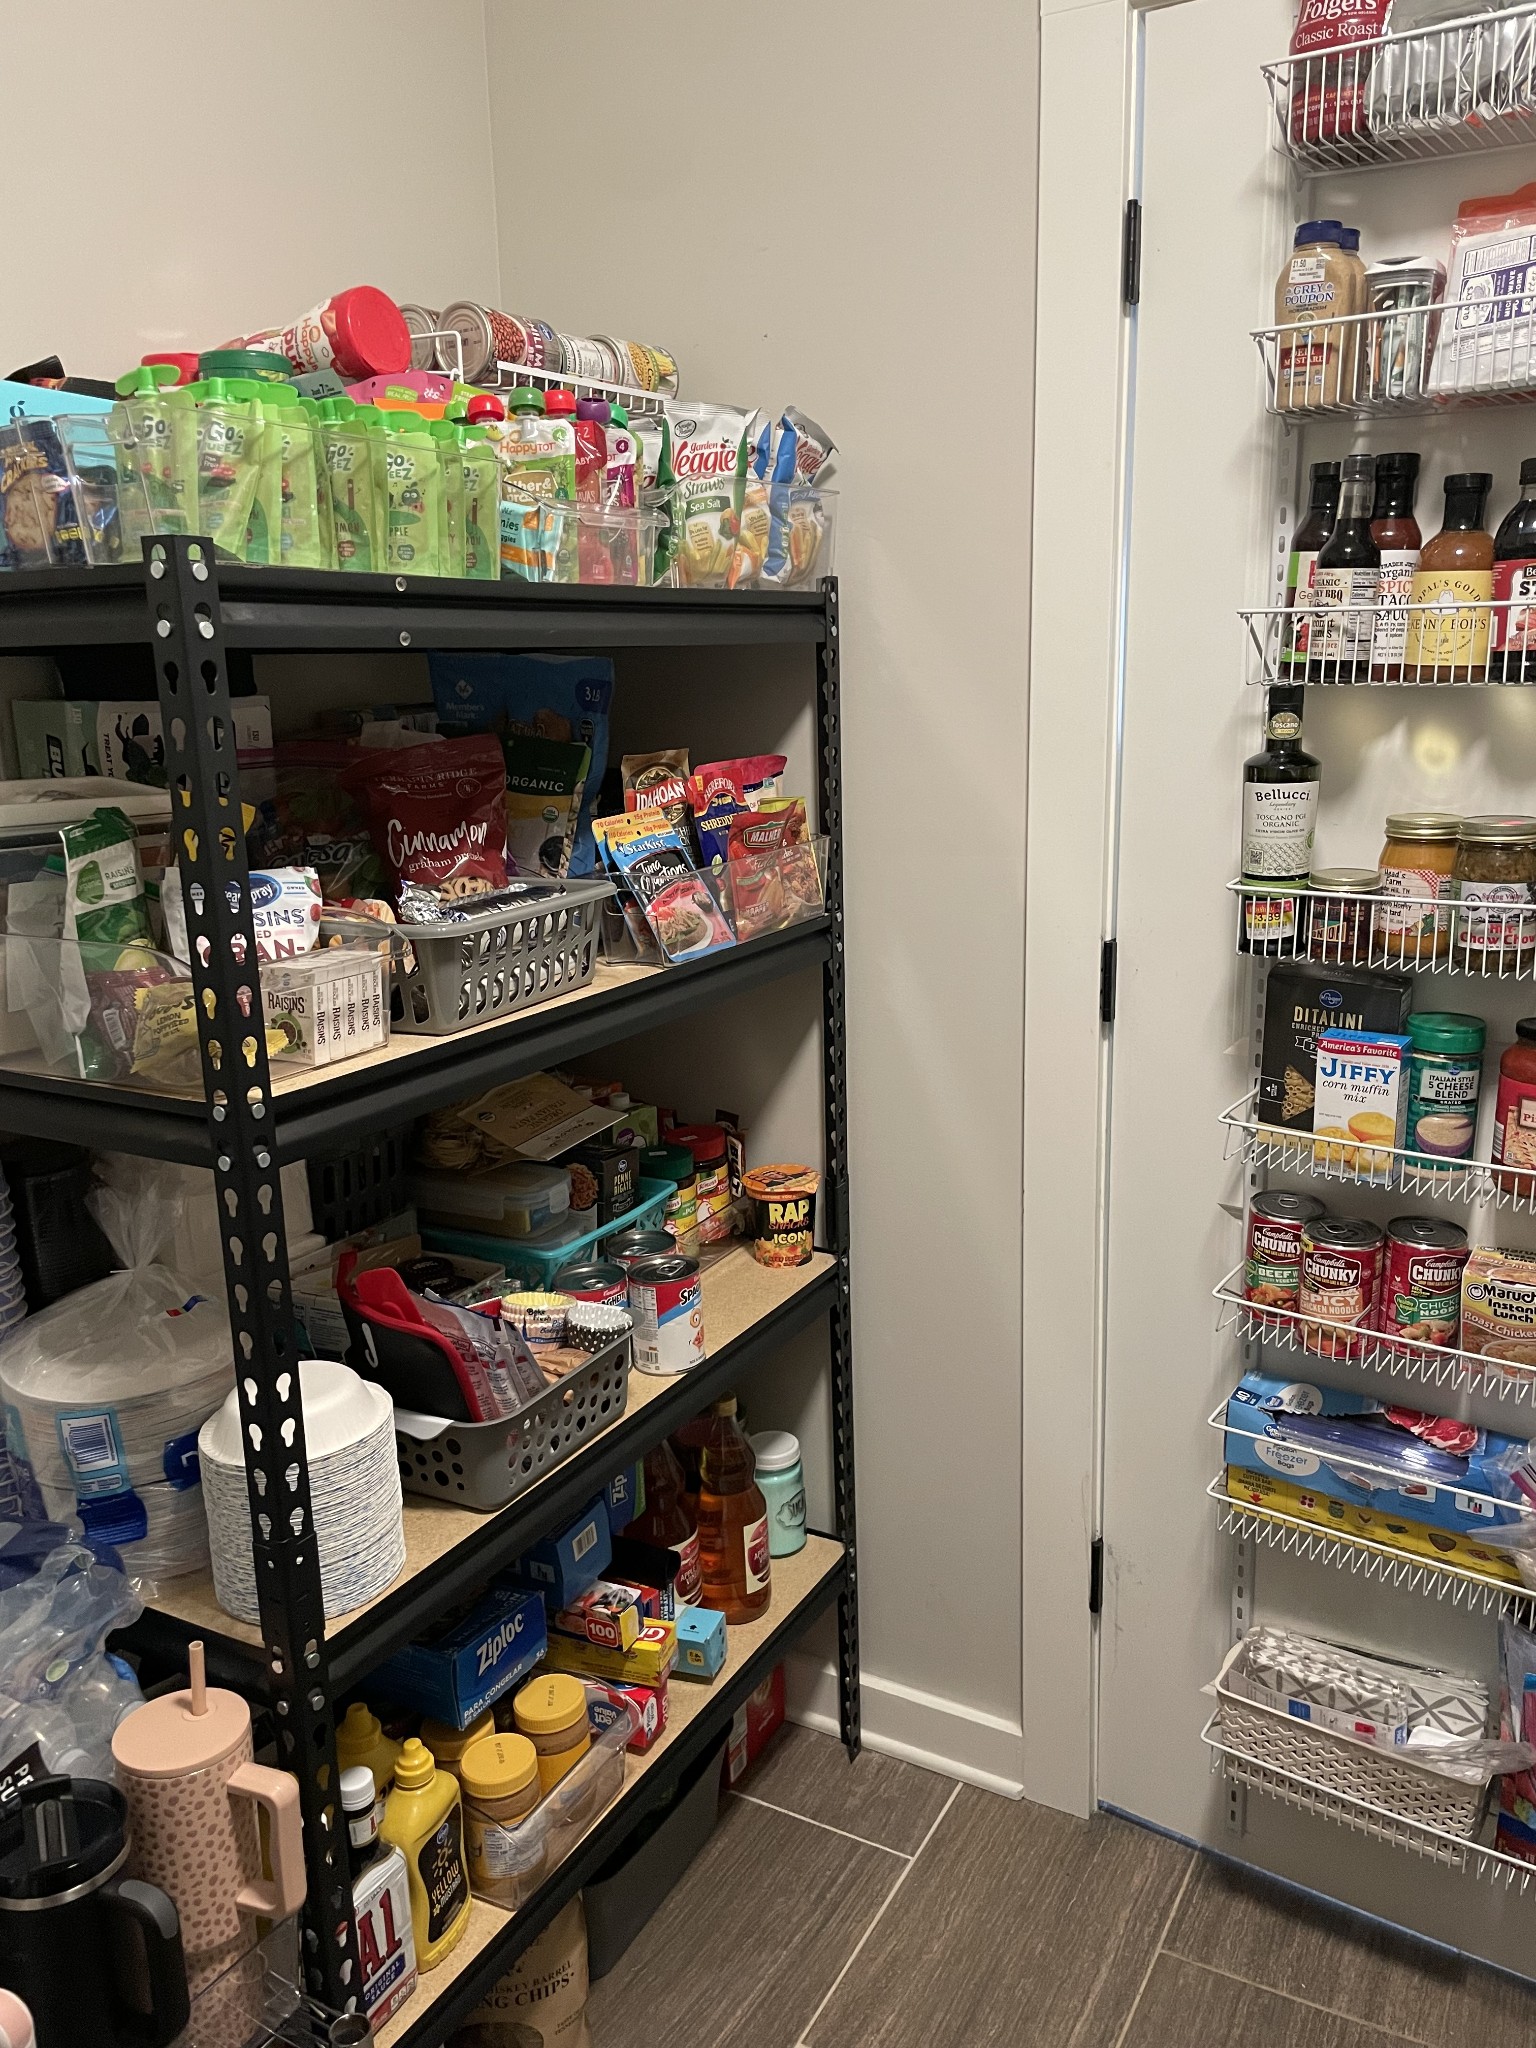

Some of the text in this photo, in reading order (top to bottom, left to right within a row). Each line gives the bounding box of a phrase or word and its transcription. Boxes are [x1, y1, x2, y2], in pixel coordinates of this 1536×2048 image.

[1301, 0, 1377, 23] Folgers
[1295, 22, 1377, 48] Classic Roast
[1293, 283, 1324, 295] GREY
[1285, 291, 1335, 306] POUPON
[690, 441, 718, 453] garden
[672, 440, 737, 481] Veggie
[684, 476, 725, 499] Straws
[690, 499, 721, 513] Sea Salt
[1325, 589, 1343, 603] BBQ
[1417, 580, 1481, 603] OPAL'S GOLD
[592, 688, 601, 702] LB
[445, 702, 485, 712] Member's
[1271, 720, 1299, 729] Toscano
[103, 733, 112, 767] TREAT
[438, 768, 478, 780] RIDGE
[407, 782, 445, 790] FARMS
[506, 775, 564, 793] ORGANIC
[636, 781, 686, 812] IDAHOAN
[1255, 789, 1310, 802] Bellucci
[605, 818, 624, 826] Calories
[643, 810, 660, 818] Protein
[1256, 813, 1293, 821] TOSCANO
[387, 818, 488, 868] Cinnamon
[624, 838, 667, 855] StarKist
[105, 866, 135, 881] RAISINS
[408, 857, 451, 874] graham
[636, 859, 662, 875] Tuna
[1386, 878, 1402, 886] Farm
[1460, 932, 1498, 945] Chow
[268, 993, 307, 1013] RAISINS
[156, 1012, 181, 1026] LEMON
[347, 1002, 356, 1036] RAISINS
[362, 998, 370, 1031] RAISINS
[1293, 1005, 1363, 1030] DITALINI
[317, 1011, 325, 1046] RAISINS
[333, 1006, 341, 1040] RAISINS
[1291, 1022, 1325, 1033] ENRICHED
[1321, 1040, 1398, 1058] America's Favorite
[1322, 1080, 1390, 1097] corn muffin
[1428, 1081, 1474, 1091] 5 CHEESE
[1344, 1092, 1367, 1104] mix
[1435, 1091, 1468, 1099] BLEND
[614, 1170, 632, 1186] PENNE
[768, 1201, 810, 1224] RAP
[768, 1218, 810, 1230] SNACKS
[773, 1230, 807, 1244] ICON
[1262, 1226, 1294, 1241] Campbell's
[1254, 1231, 1300, 1255] CHUNKY
[1313, 1253, 1346, 1268] Campbell's
[1424, 1258, 1457, 1268] Campbell's
[1258, 1270, 1292, 1279] BEEF
[1305, 1257, 1358, 1283] CHUNKY
[1412, 1265, 1462, 1281] CHUNKY
[1301, 1291, 1359, 1307] SPICY
[1301, 1302, 1359, 1315] CHICKEN NOODLE
[1493, 1308, 1534, 1324] Lunch
[1464, 1312, 1495, 1330] Roast
[1266, 1447, 1308, 1465] Freezer
[1277, 1460, 1295, 1469] Bags
[588, 1622, 615, 1639] 100
[476, 1613, 524, 1677] Ziploc
[463, 1700, 485, 1719] PARA
[484, 1662, 523, 1702] CONGELAR
[431, 1858, 460, 1903] YELLOW
[358, 1887, 403, 1983] A1
[365, 1960, 401, 2001] ORIGINAL
[533, 1960, 572, 1986] BARREL
[371, 1972, 397, 2002] SAUCE
[514, 1973, 570, 2006] CHIPS
